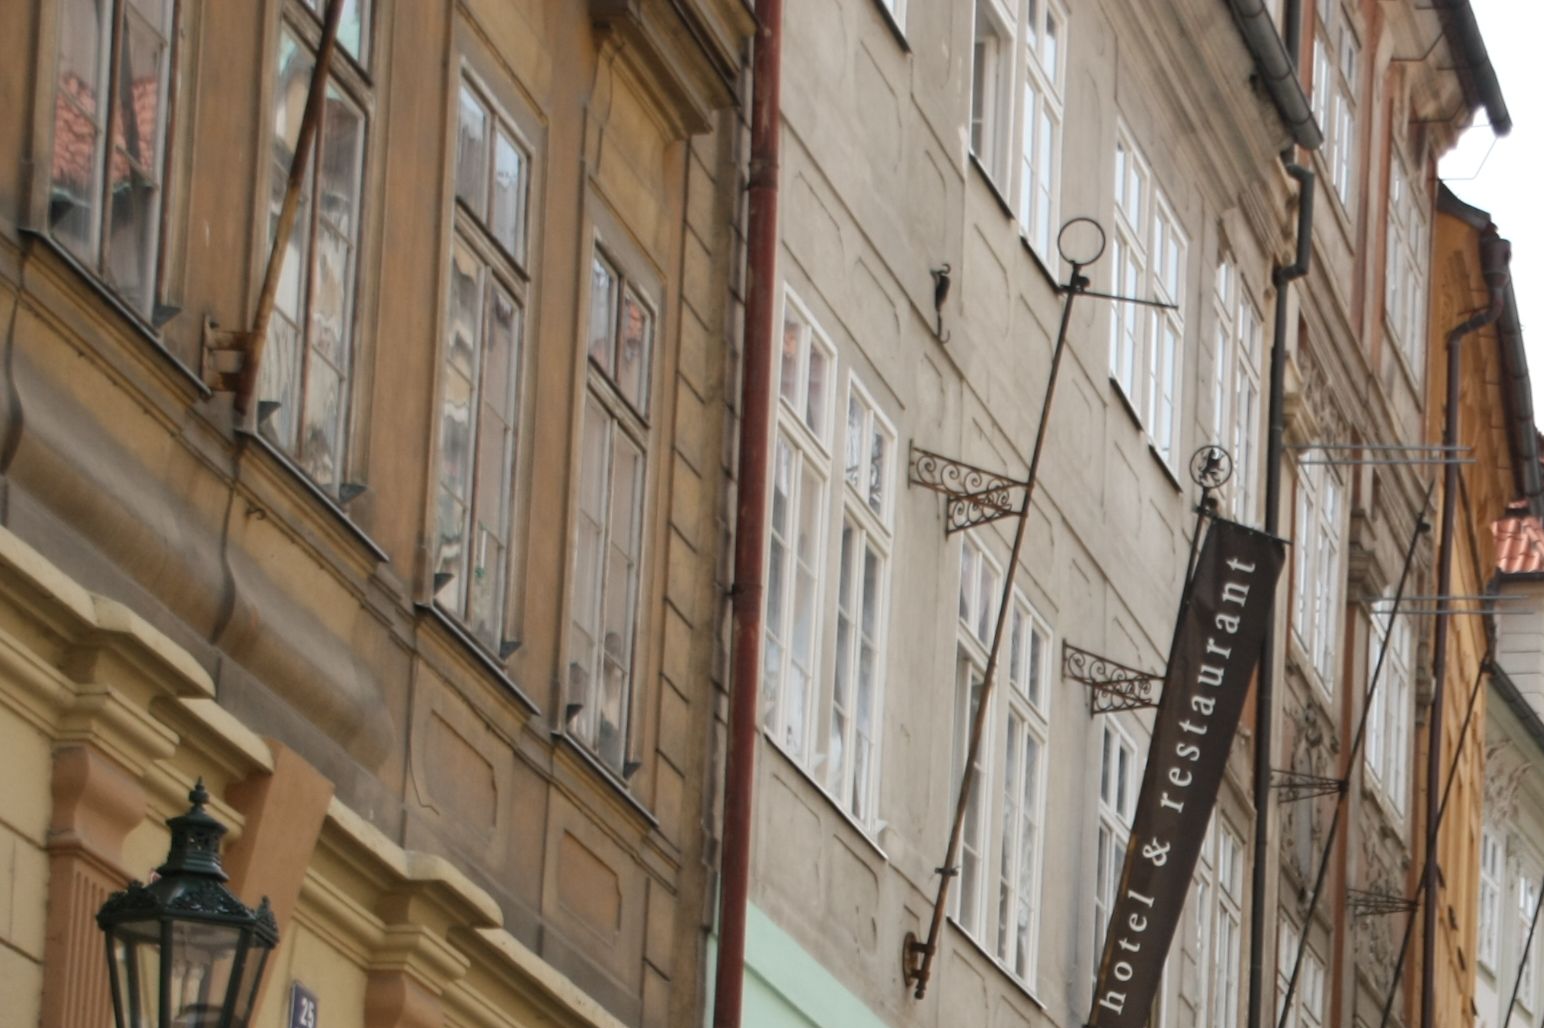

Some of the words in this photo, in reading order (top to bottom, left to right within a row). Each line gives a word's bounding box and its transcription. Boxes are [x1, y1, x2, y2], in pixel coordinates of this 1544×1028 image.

[1099, 888, 1155, 1015] hotel
[1142, 837, 1171, 868] &
[1160, 556, 1257, 814] restaurant
